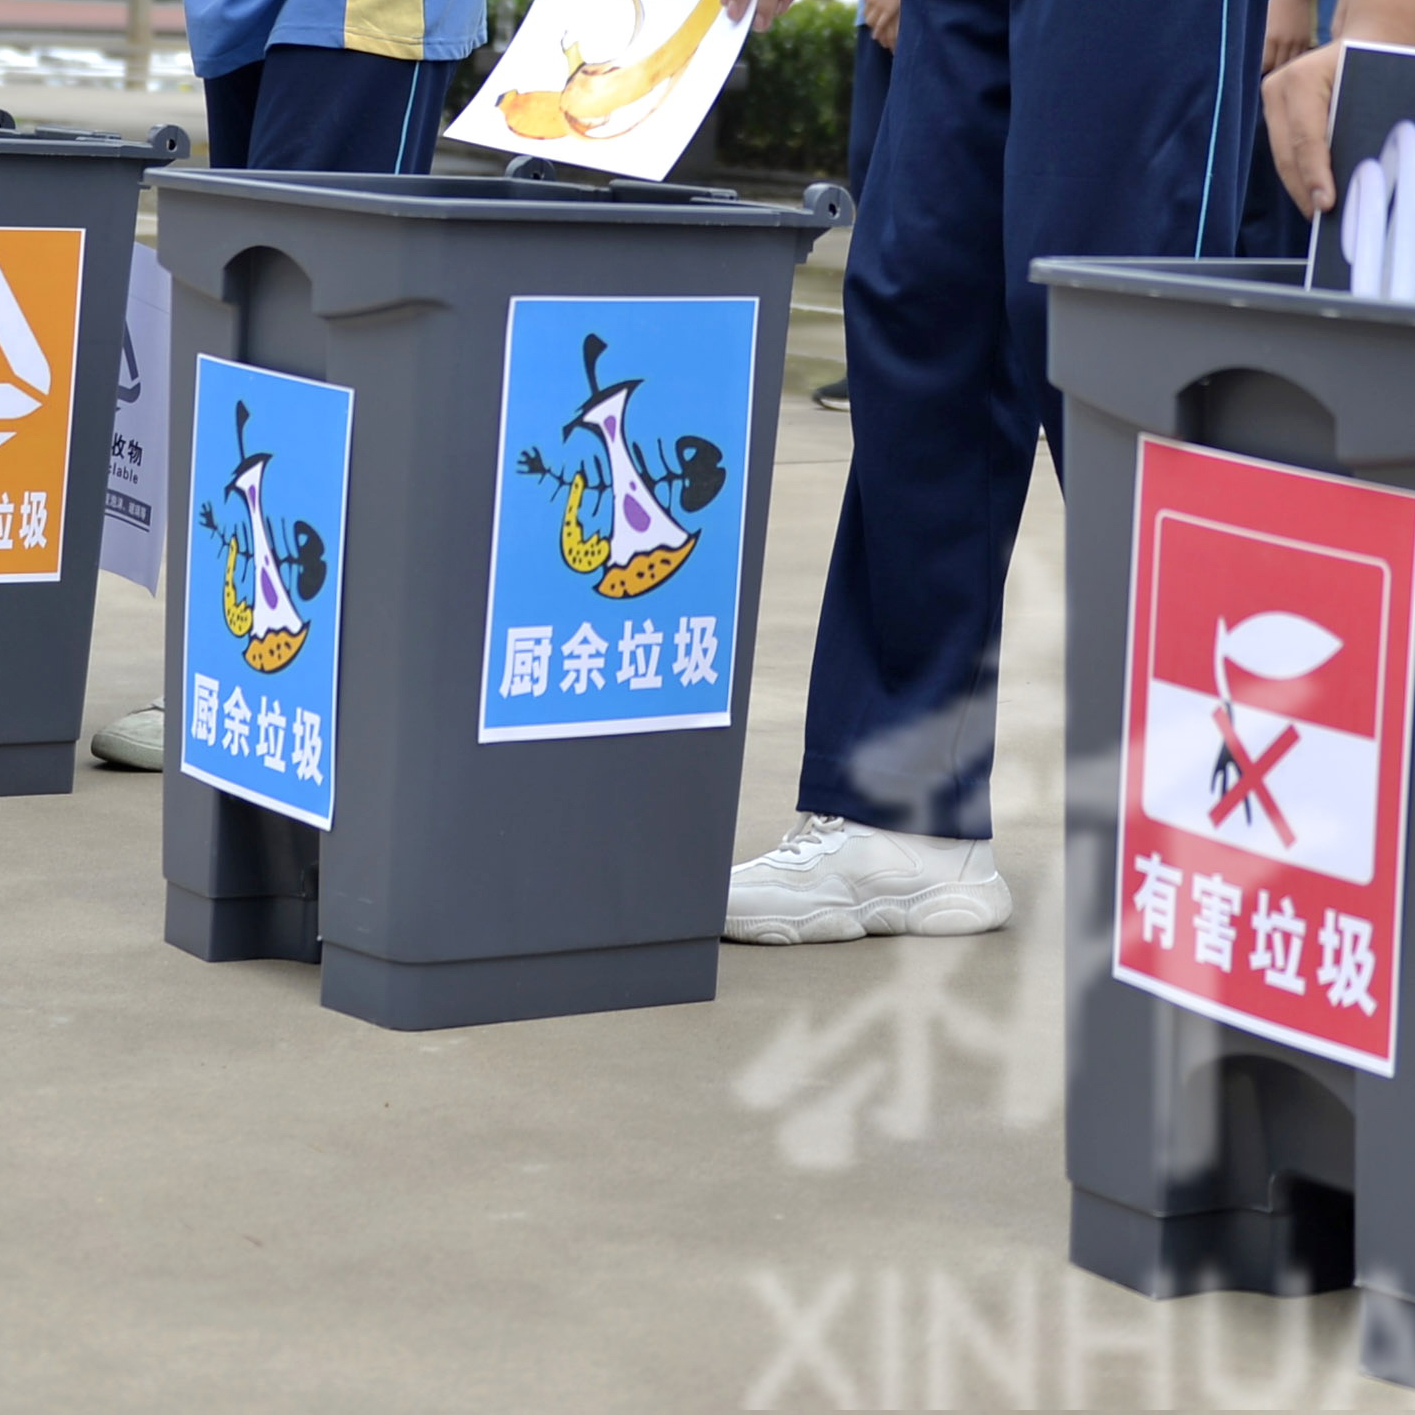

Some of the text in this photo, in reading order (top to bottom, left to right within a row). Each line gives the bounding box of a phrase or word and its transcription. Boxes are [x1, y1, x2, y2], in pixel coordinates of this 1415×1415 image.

[499, 615, 719, 699] 厨余垃圾
[191, 672, 323, 785] 厨余垃圾
[1133, 852, 1377, 1016] 有害垃圾
